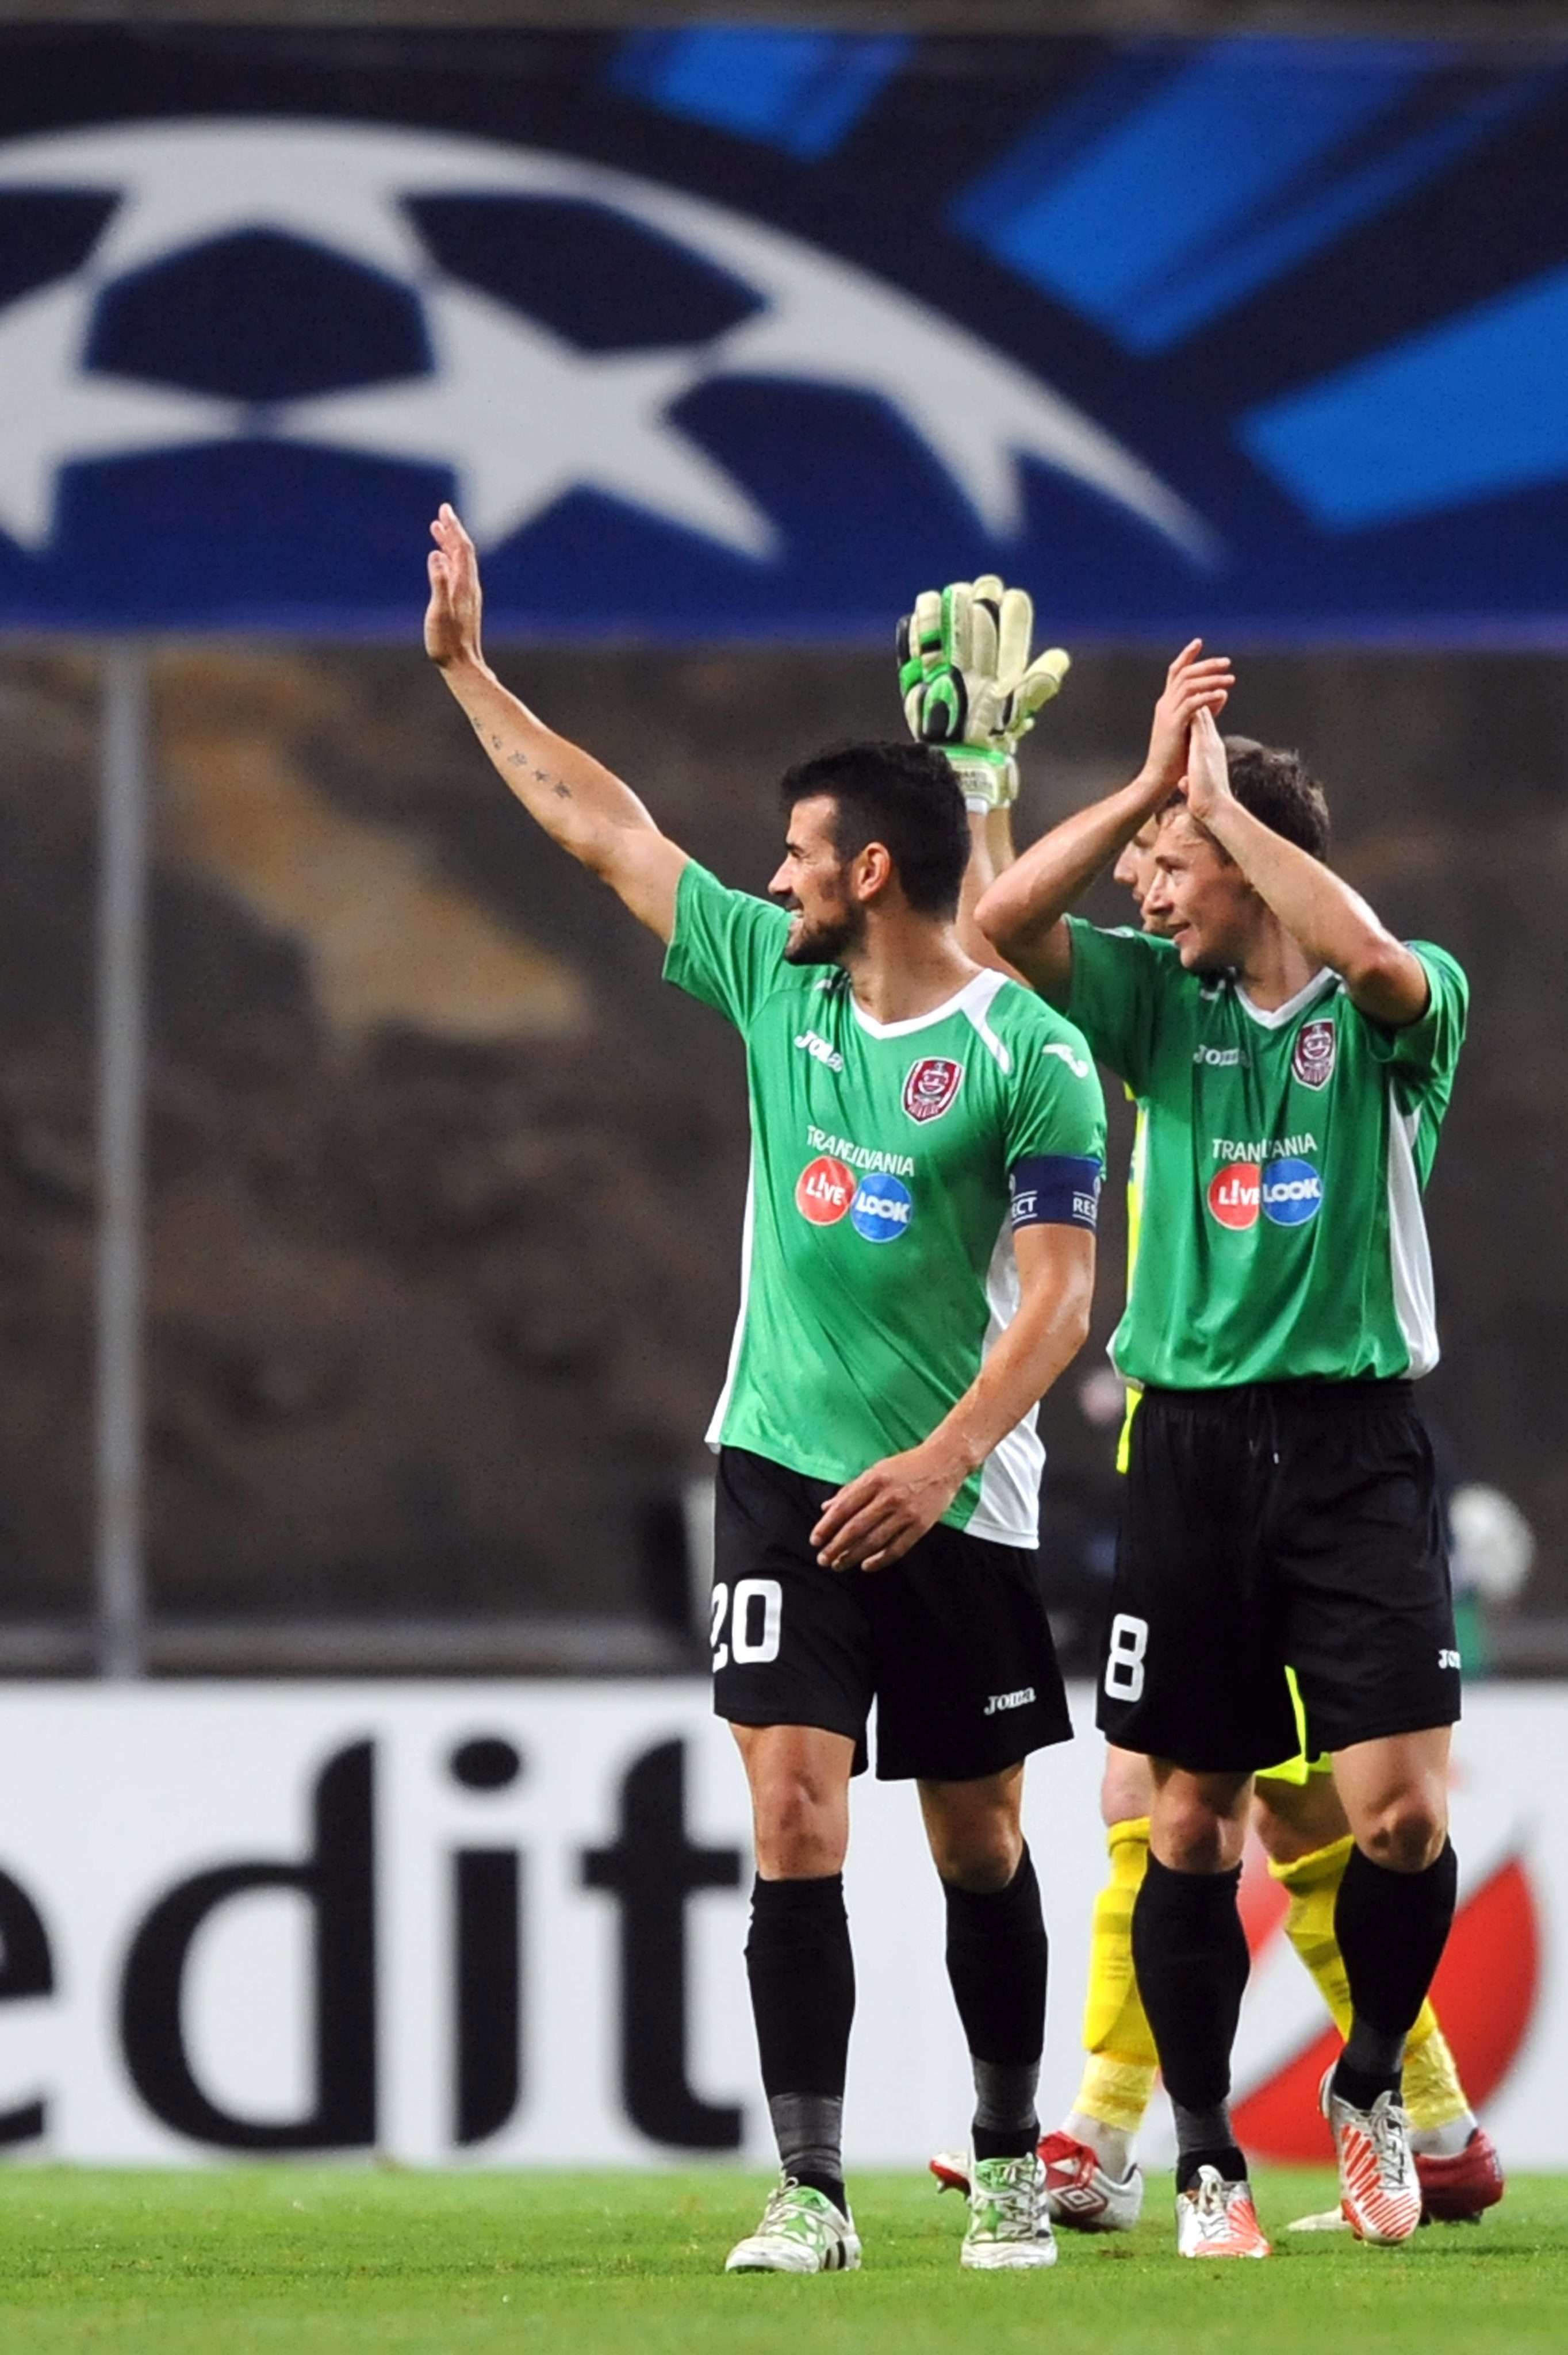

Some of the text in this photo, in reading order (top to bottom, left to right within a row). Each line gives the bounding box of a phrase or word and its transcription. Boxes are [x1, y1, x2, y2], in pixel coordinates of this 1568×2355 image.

[855, 1192, 911, 1223] LOOK
[1263, 1178, 1321, 1203] LOOK
[710, 1579, 782, 1673] 20
[1104, 1612, 1148, 1702] 8
